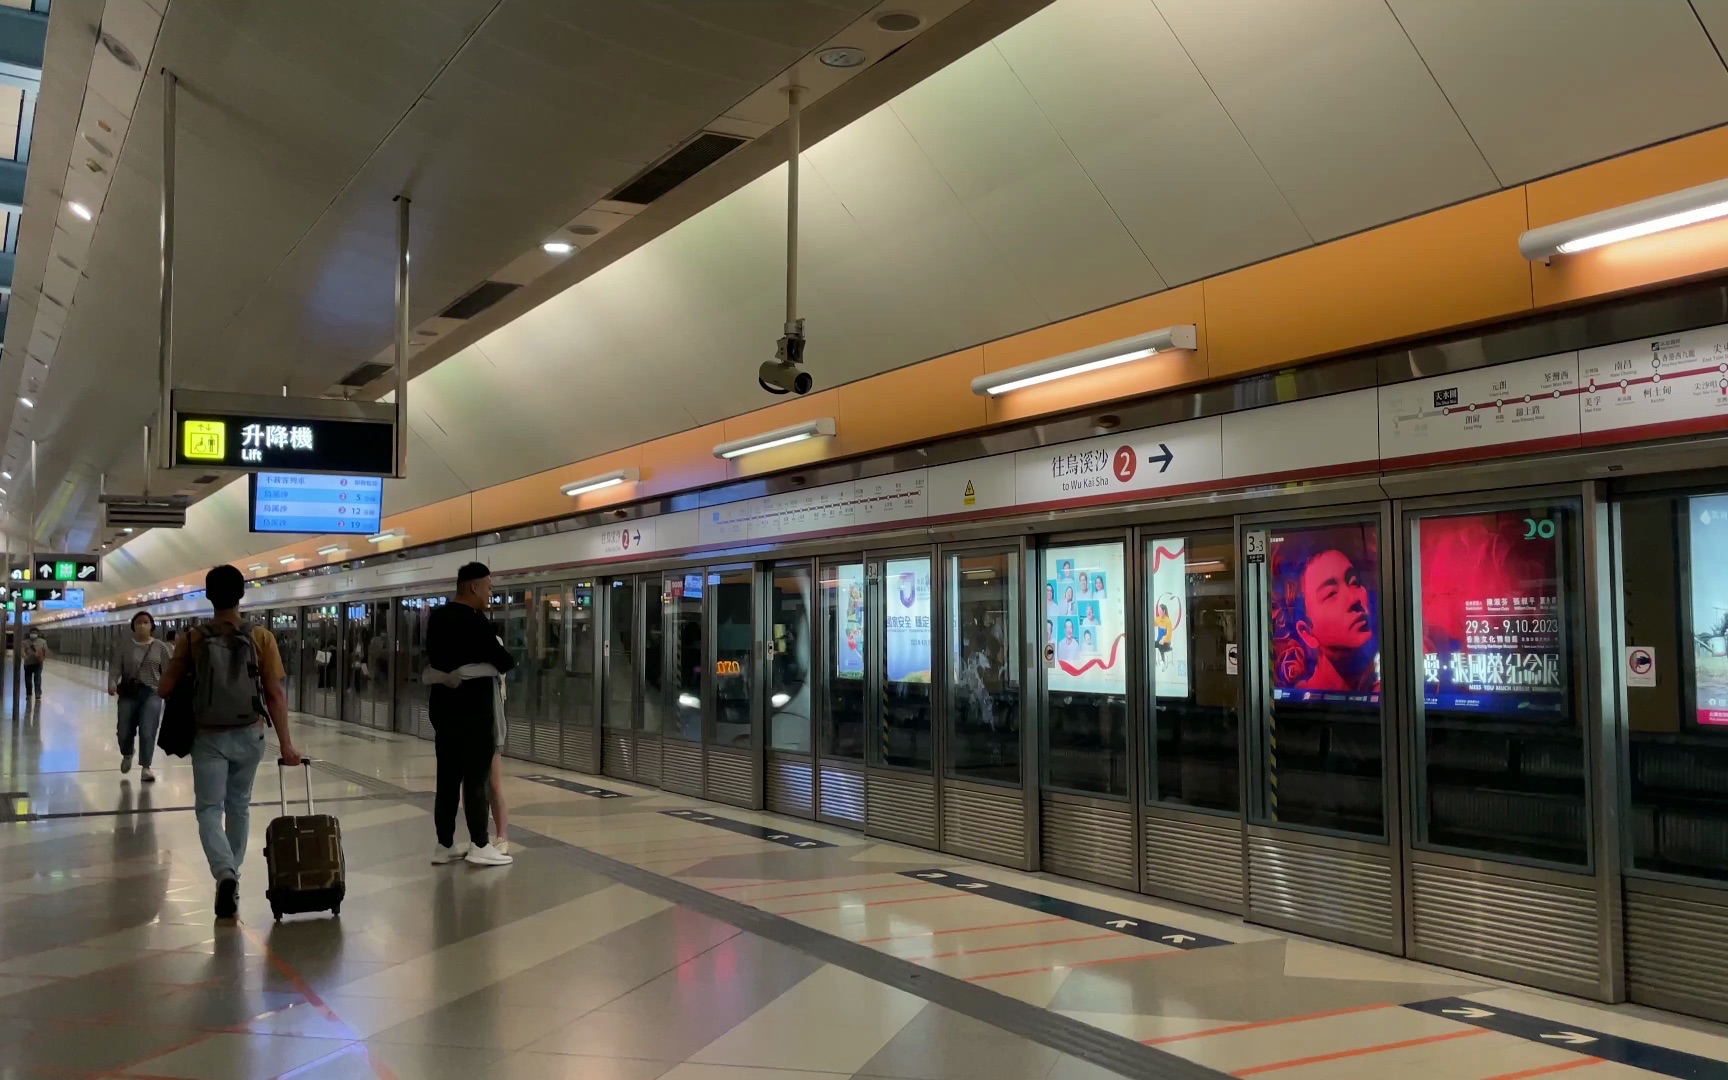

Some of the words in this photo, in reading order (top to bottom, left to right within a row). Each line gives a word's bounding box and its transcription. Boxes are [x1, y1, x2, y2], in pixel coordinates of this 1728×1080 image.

[1614, 360, 1632, 371] 南昌
[1644, 386, 1672, 398] 柯士甸
[1586, 396, 1601, 406] 美孚
[241, 424, 314, 450] 升降機
[241, 448, 262, 462] Lift
[1052, 449, 1108, 478] 往烏溪沙
[1120, 452, 1130, 476] 2
[1063, 482, 1070, 490] to
[1071, 479, 1082, 489] Wu
[1084, 476, 1094, 488] Kai
[1096, 476, 1108, 486] Sha
[1248, 536, 1264, 552] 3-3
[1466, 620, 1489, 633] 29.3
[1503, 619, 1558, 633] 9.10.2023
